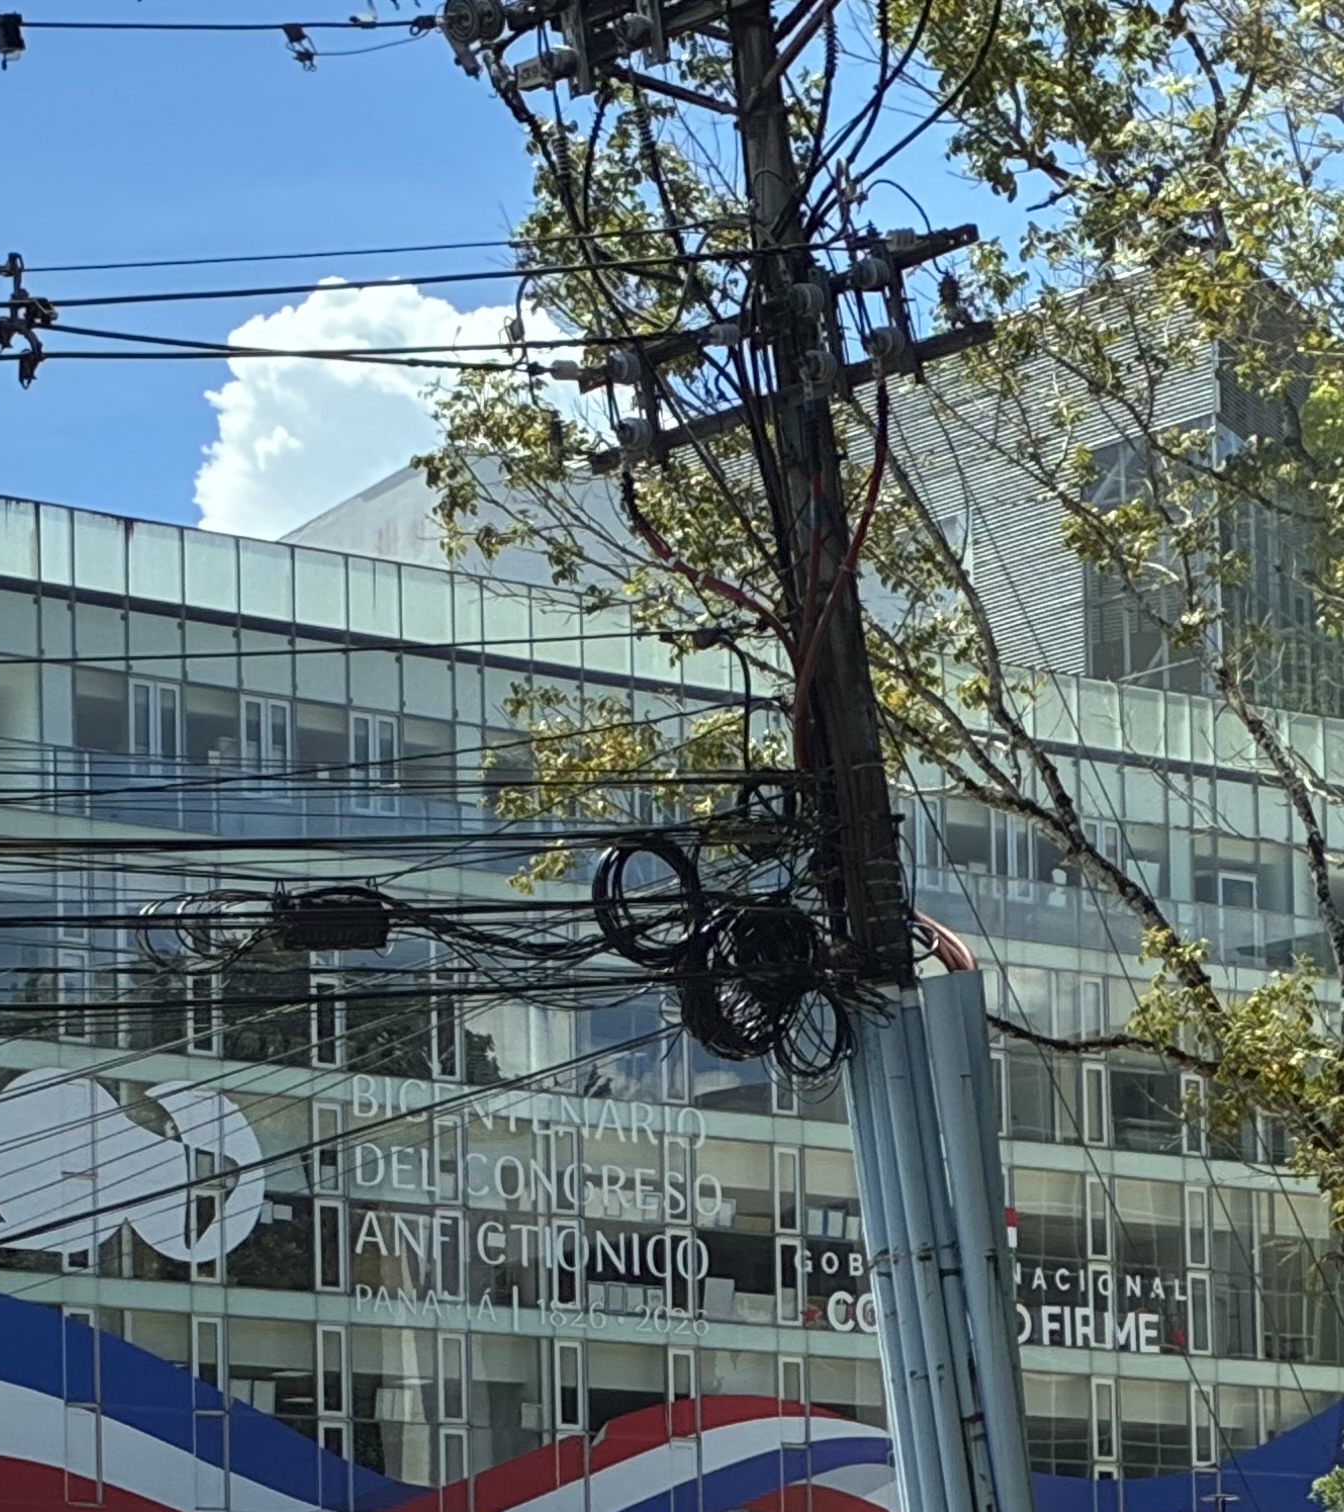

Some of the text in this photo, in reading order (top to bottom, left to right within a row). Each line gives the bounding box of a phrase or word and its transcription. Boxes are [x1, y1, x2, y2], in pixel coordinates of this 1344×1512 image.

[356, 1142, 440, 1192] DEL
[466, 1153, 723, 1216] CONGRESO
[1042, 1305, 1161, 1353] FIRME
